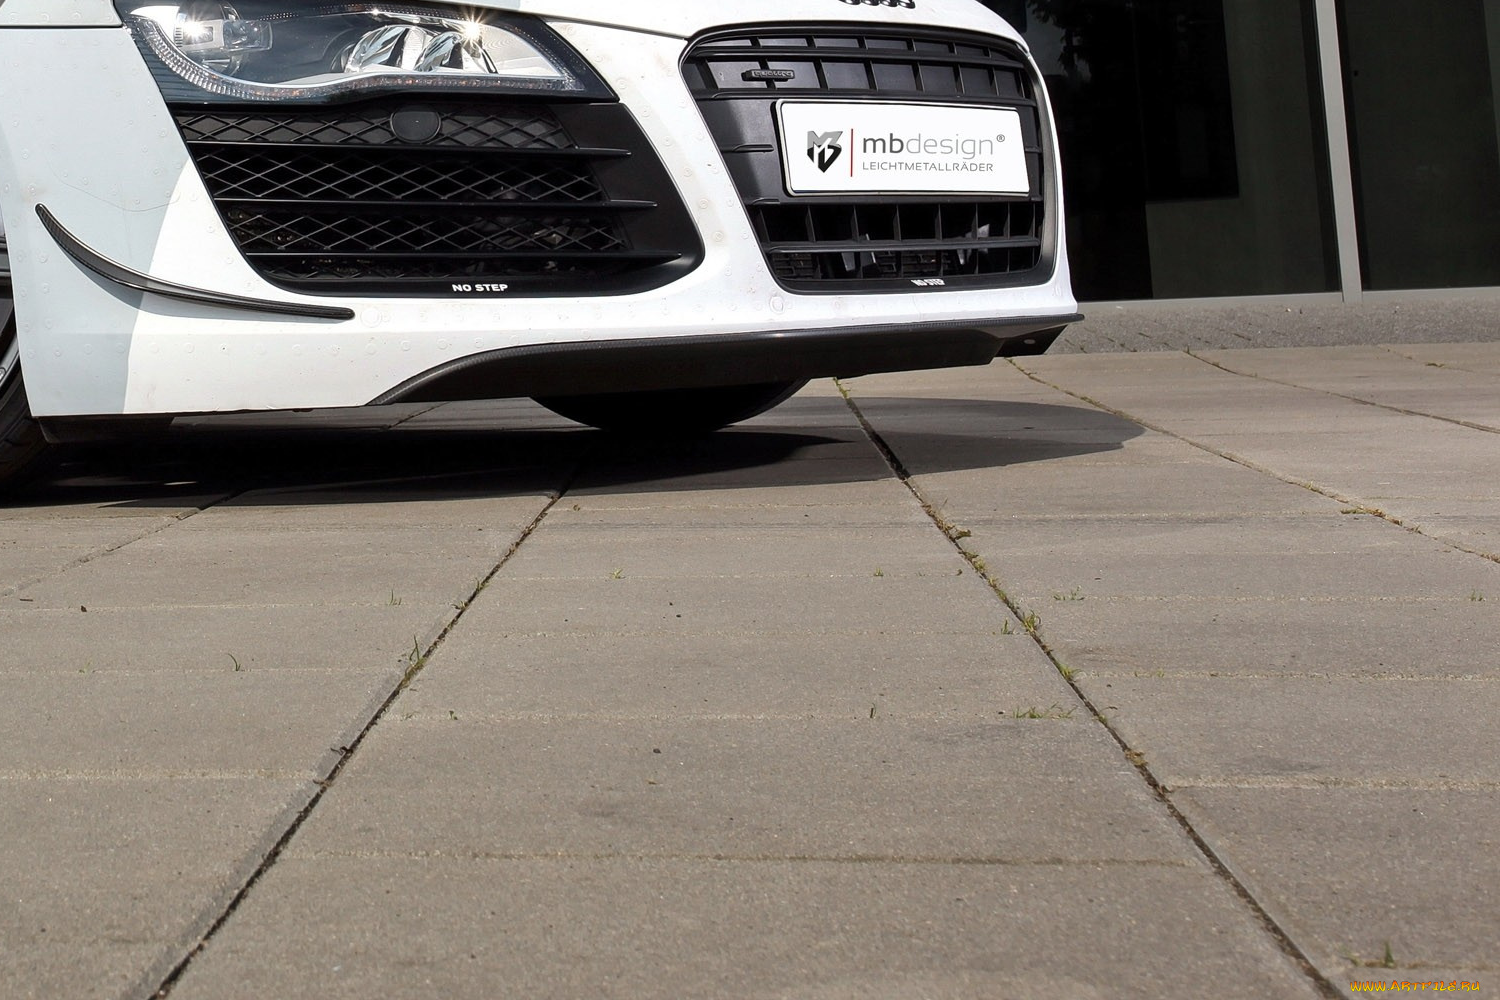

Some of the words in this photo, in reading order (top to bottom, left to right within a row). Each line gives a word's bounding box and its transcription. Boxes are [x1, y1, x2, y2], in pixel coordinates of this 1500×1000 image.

[862, 161, 994, 172] LEICHTMETALLRÄDER
[451, 284, 472, 292] NO
[474, 284, 508, 292] STEP
